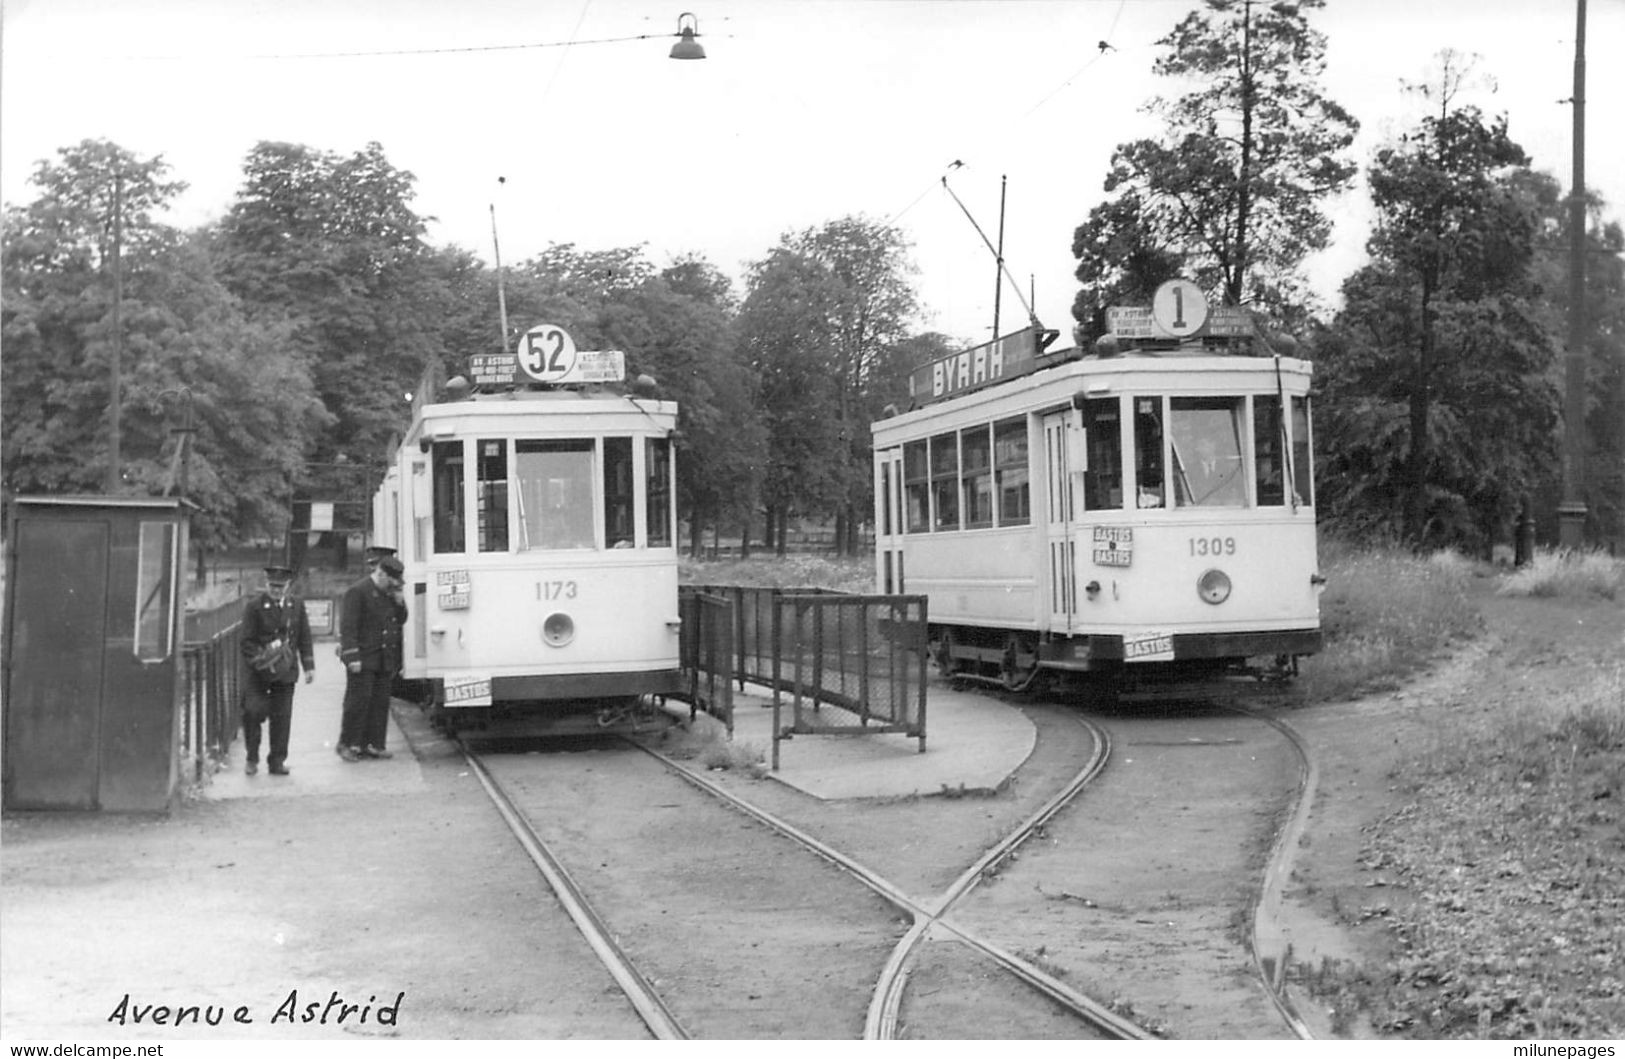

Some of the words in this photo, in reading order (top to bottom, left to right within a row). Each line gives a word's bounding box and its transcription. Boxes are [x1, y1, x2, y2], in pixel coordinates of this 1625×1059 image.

[1172, 286, 1187, 328] 1
[526, 330, 566, 374] 52
[933, 340, 1004, 397] BYRRH
[1094, 527, 1132, 541] BASTOS
[1188, 537, 1236, 557] 1309
[1094, 551, 1131, 565] BASTOS
[535, 580, 577, 601] 1173
[1125, 638, 1172, 658] BASTOS
[107, 994, 253, 1027] Avenue
[270, 989, 406, 1027] Astrid
